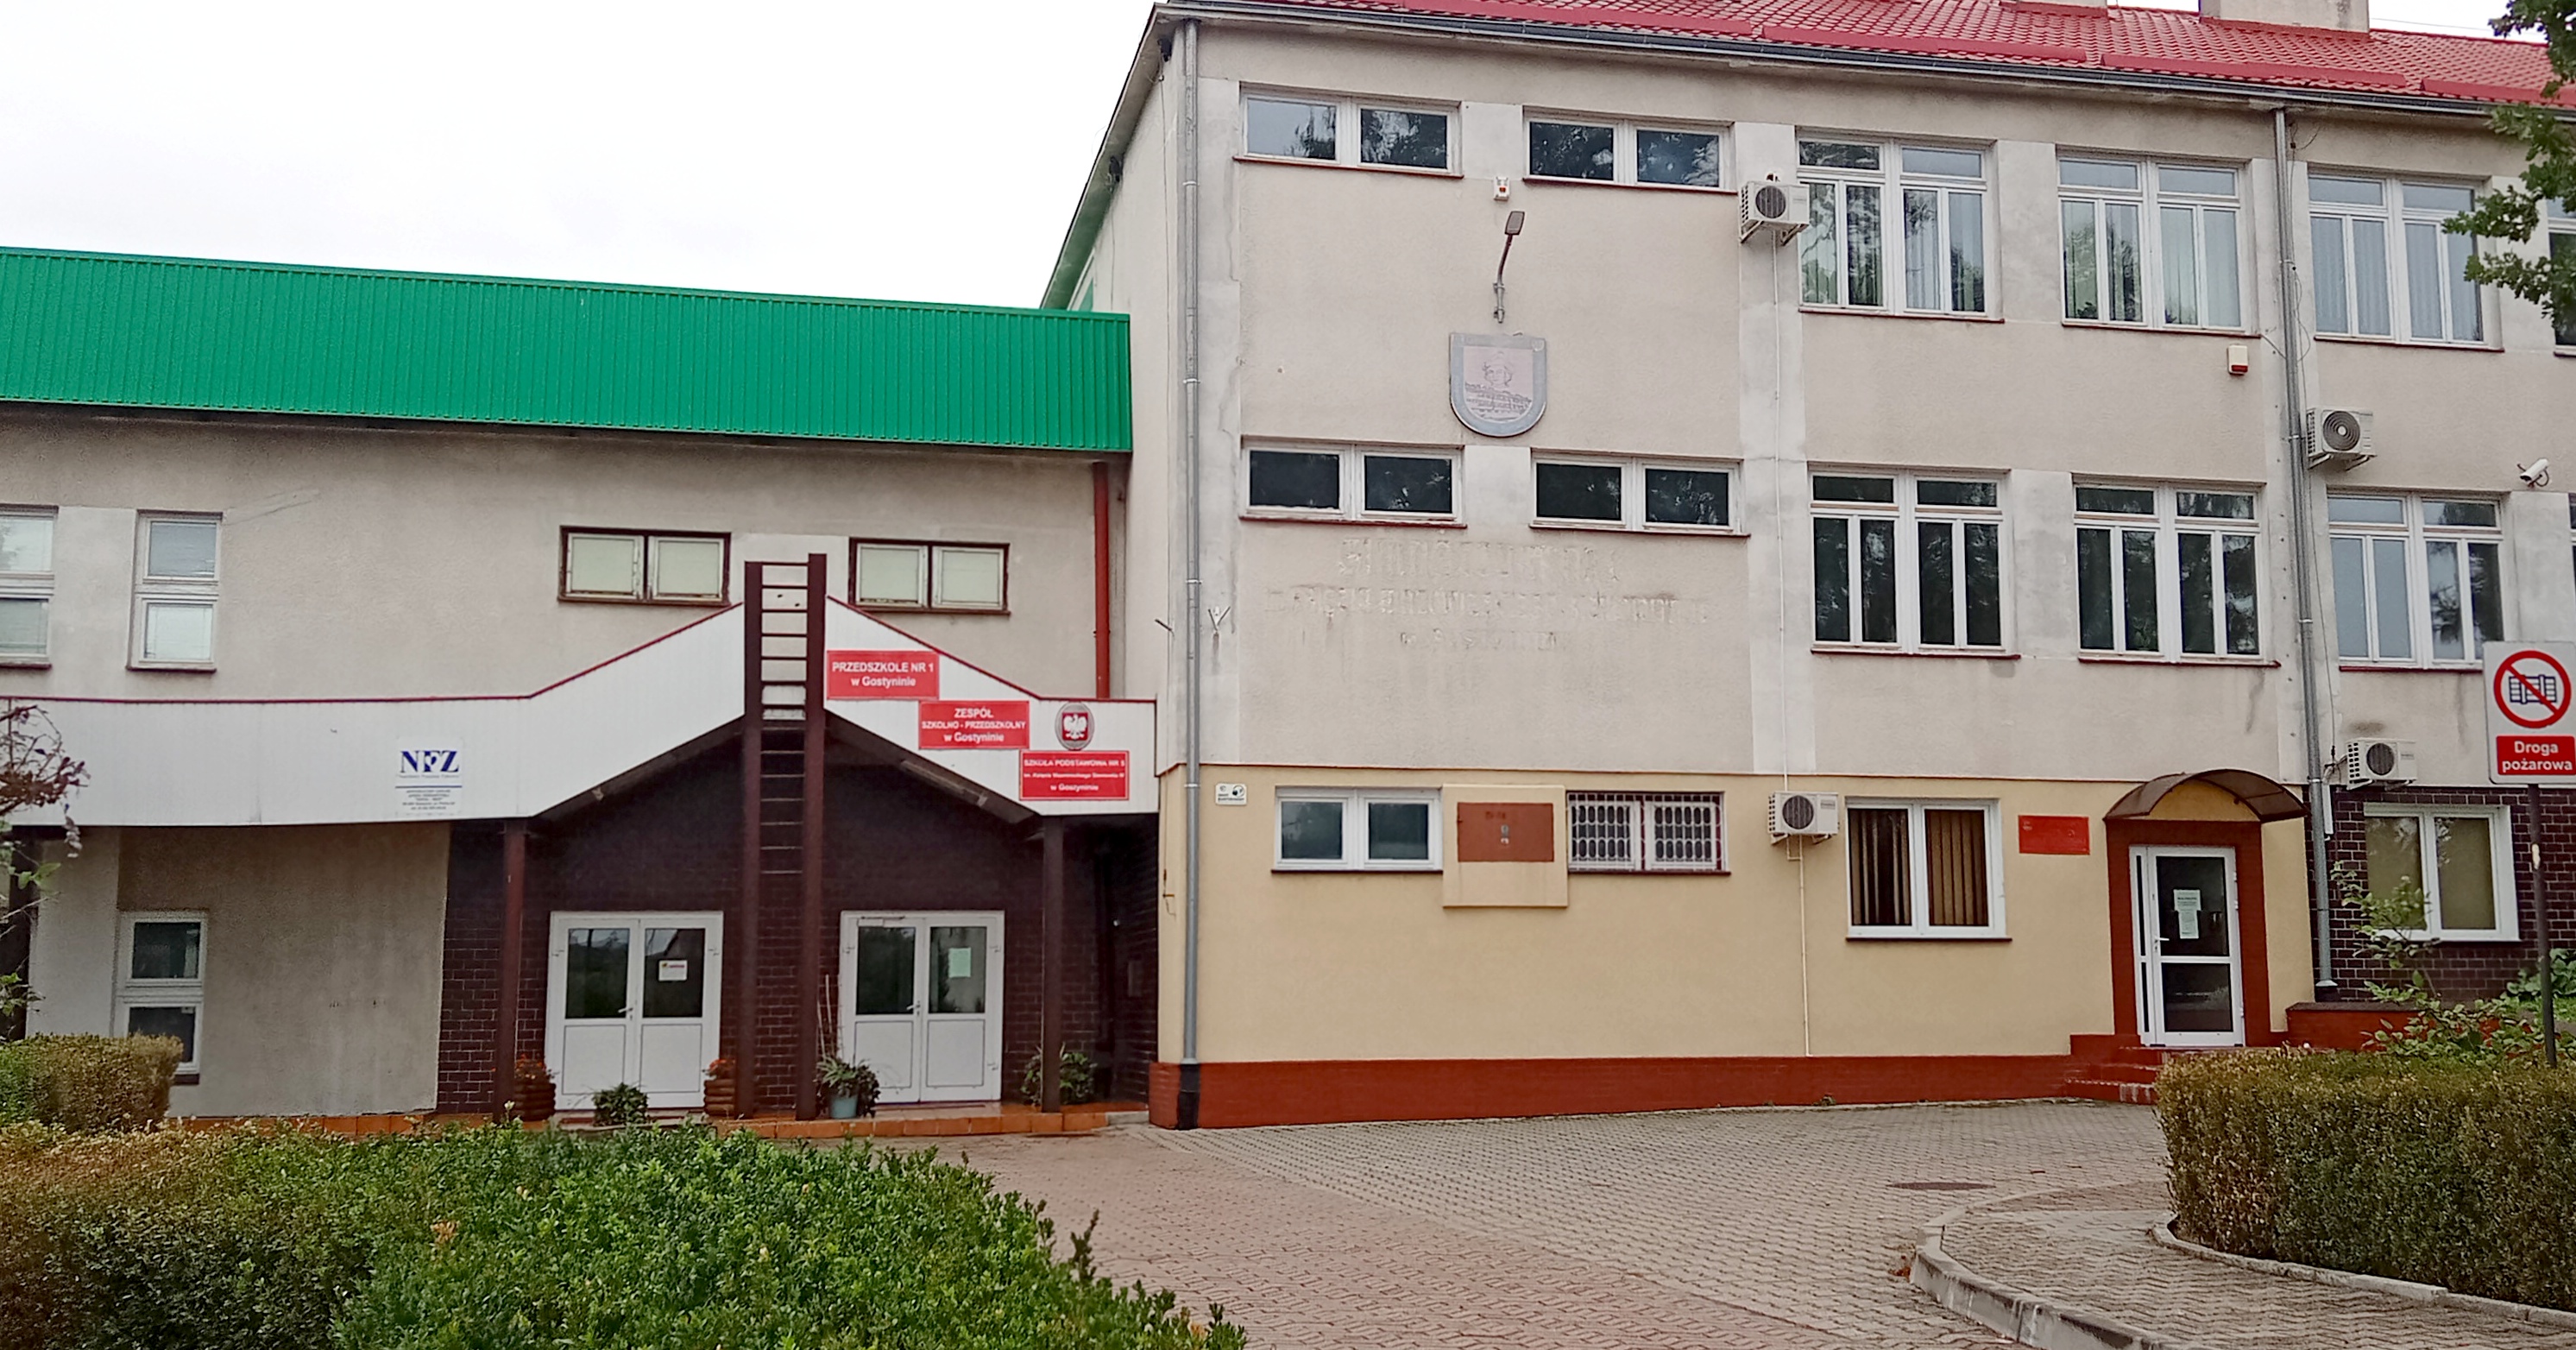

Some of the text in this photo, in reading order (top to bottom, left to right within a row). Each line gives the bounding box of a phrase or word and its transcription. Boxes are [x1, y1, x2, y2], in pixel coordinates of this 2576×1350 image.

[832, 661, 934, 672] PRZEDSZKOLE NR 1
[850, 676, 916, 689] w Gostyninie
[954, 706, 994, 718] ZESPÓŁ
[922, 721, 960, 729] SZKOLNO
[965, 721, 1026, 729] PRZEDSZKOLNY
[943, 731, 1005, 744] w Gostyninie
[2514, 741, 2559, 756] Droga
[400, 750, 460, 773] NFZ
[1055, 759, 1107, 767] PODSTAWOWA
[2502, 758, 2573, 773] pożarowa
